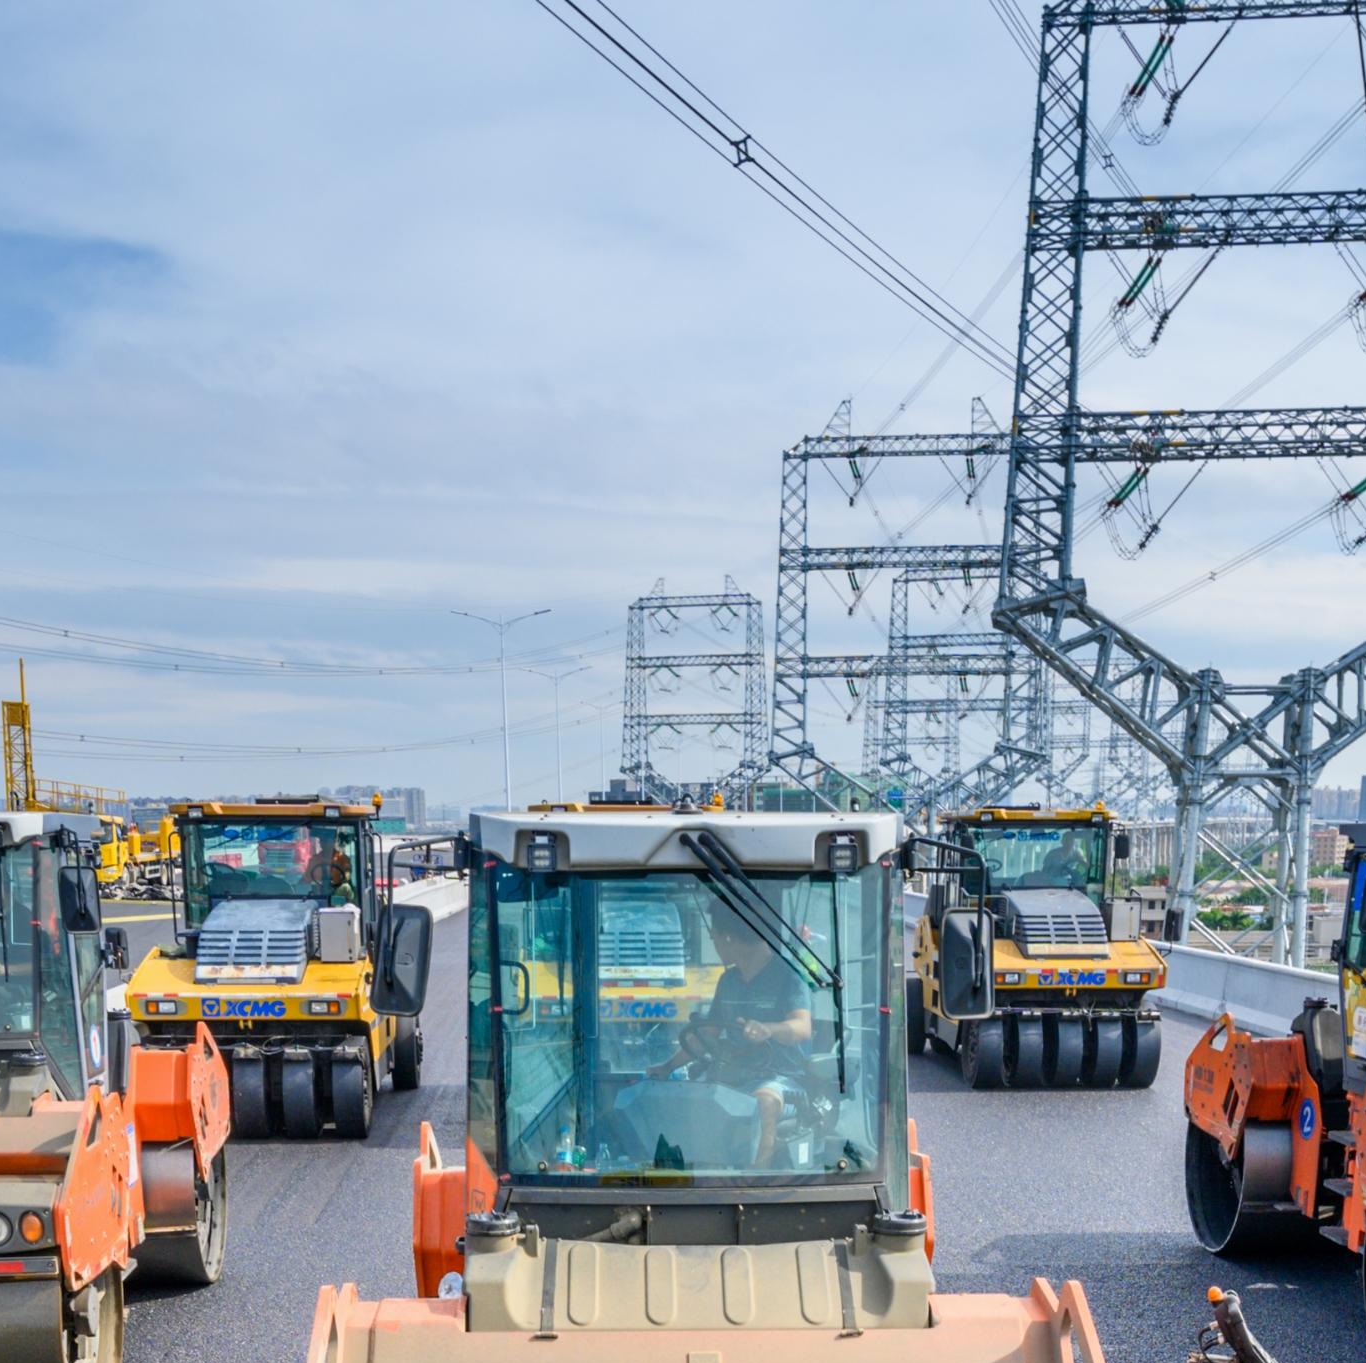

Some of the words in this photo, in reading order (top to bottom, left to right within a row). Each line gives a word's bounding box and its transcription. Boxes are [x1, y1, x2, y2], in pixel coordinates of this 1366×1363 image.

[1057, 972, 1106, 985] XCMG
[225, 1000, 286, 1017] XCMG
[1303, 1105, 1312, 1133] 2
